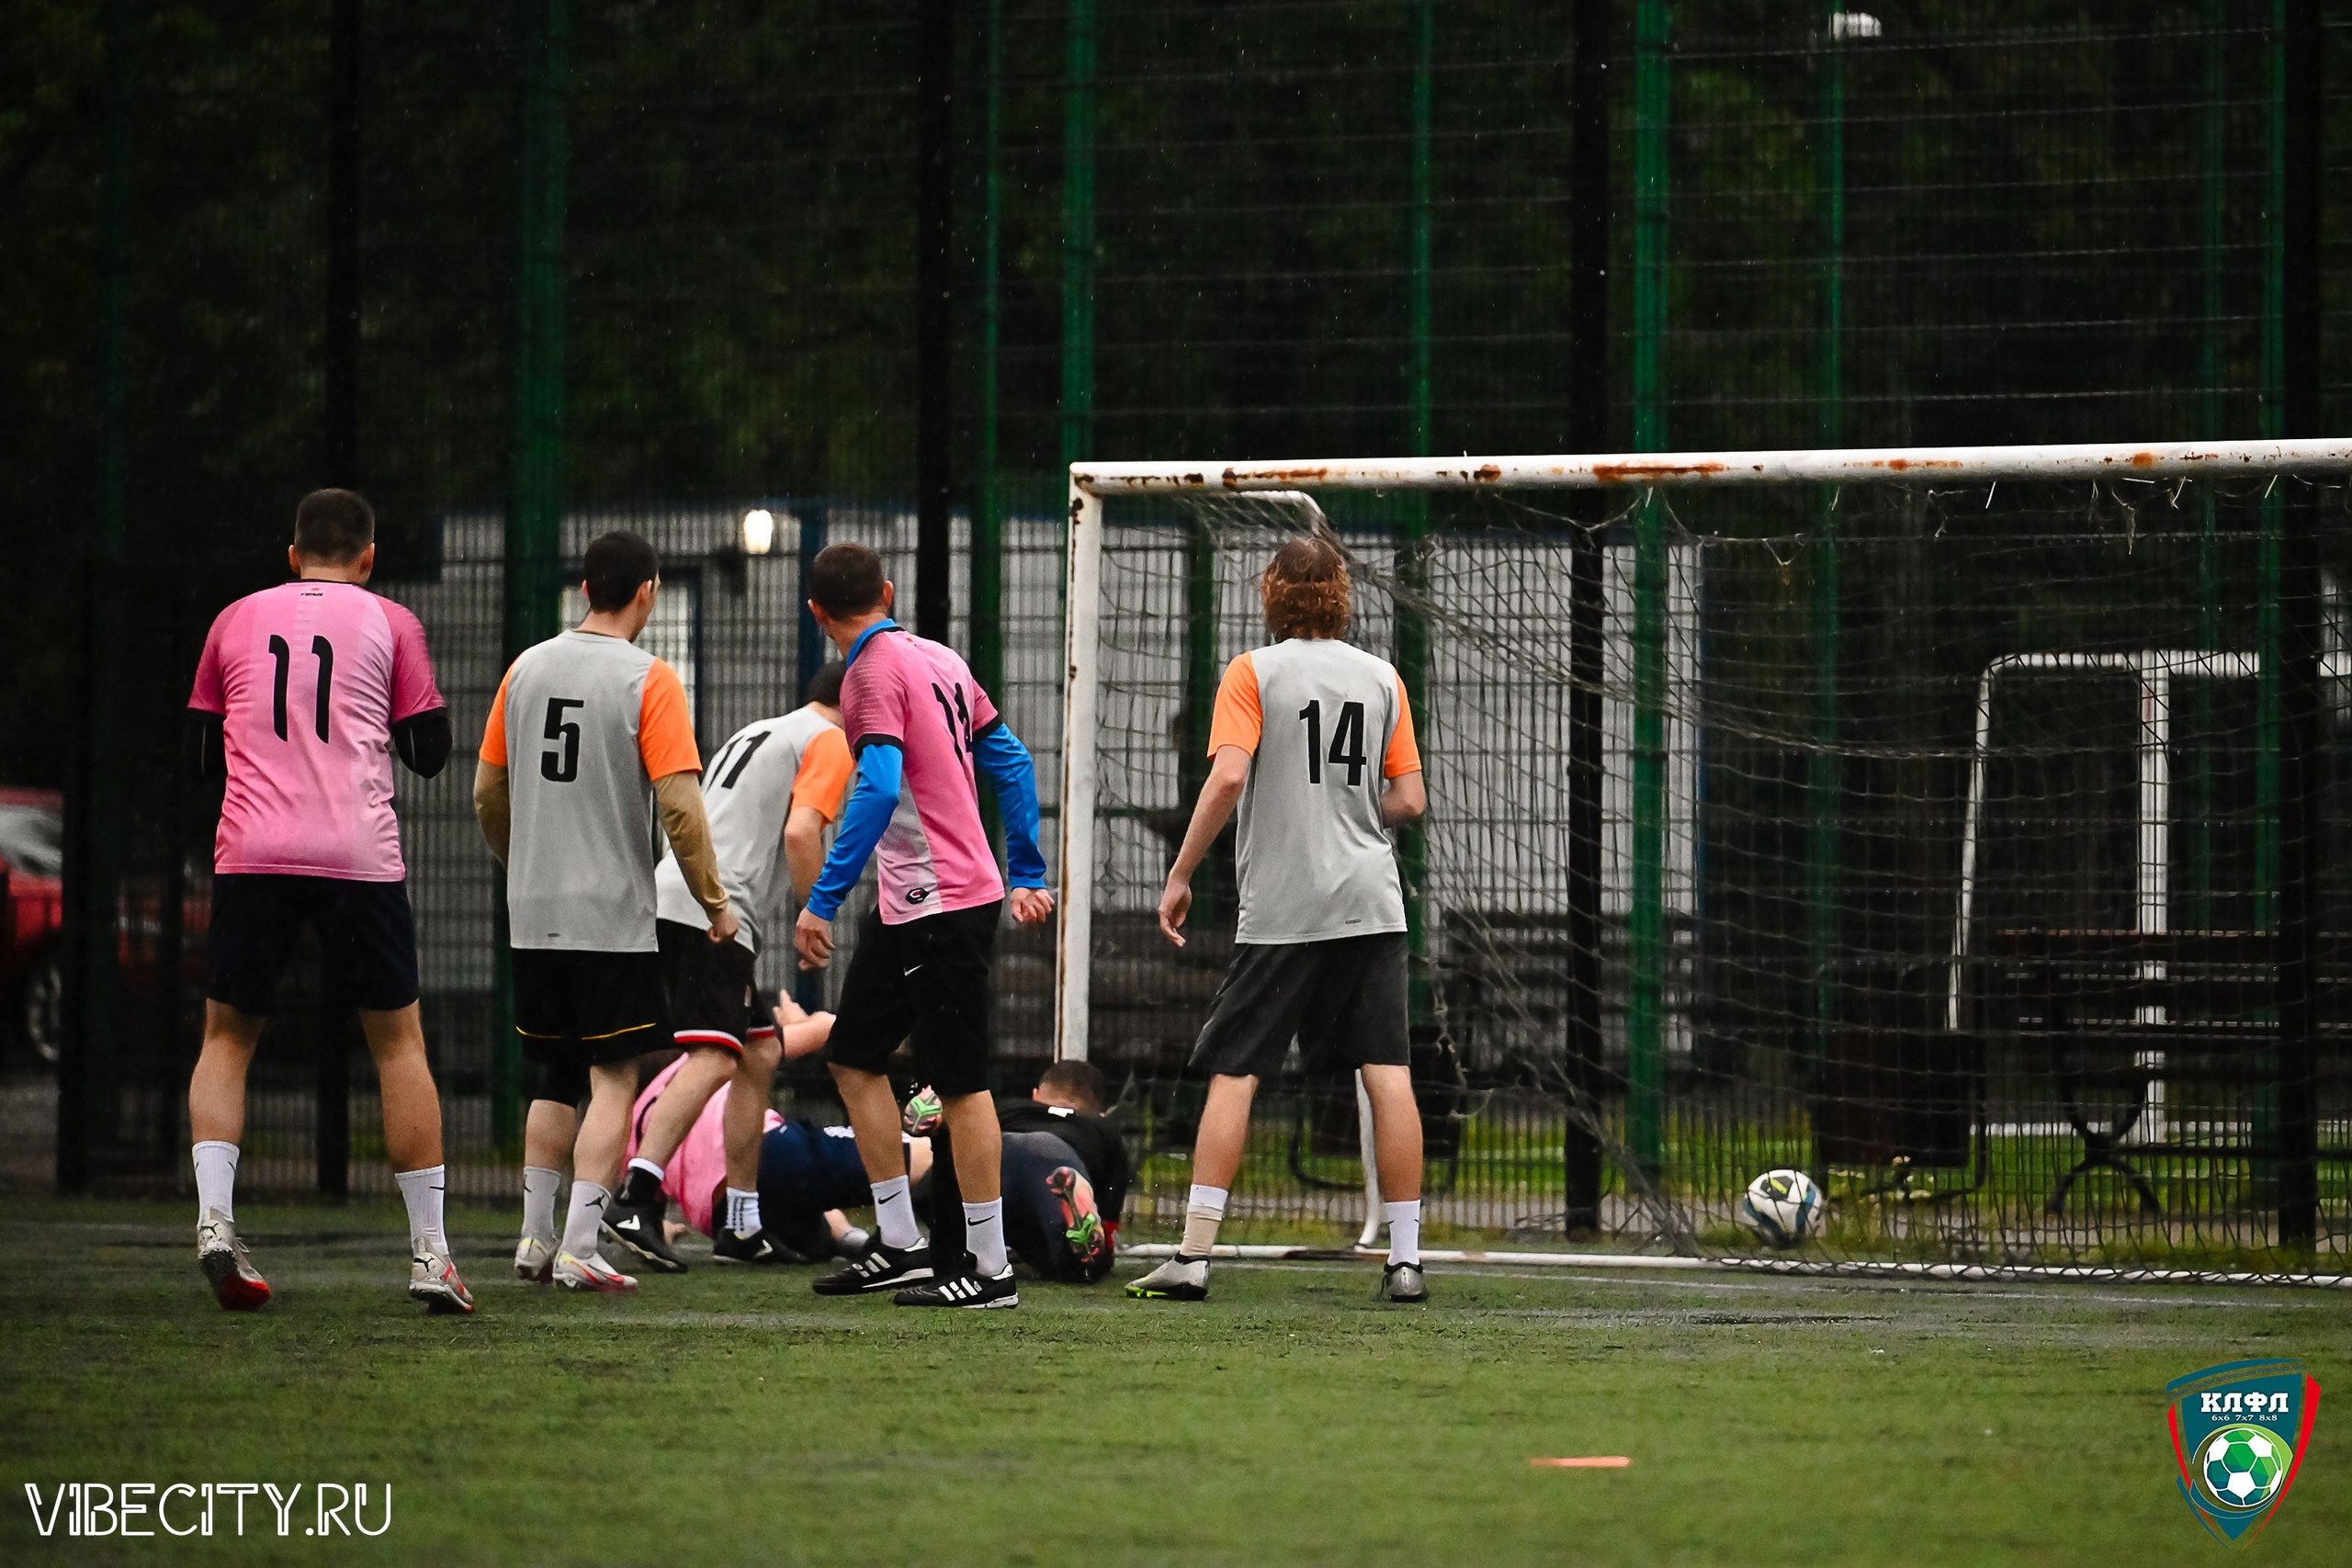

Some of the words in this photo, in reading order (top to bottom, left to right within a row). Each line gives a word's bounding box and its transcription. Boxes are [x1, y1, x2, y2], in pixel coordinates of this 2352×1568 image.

[268, 635, 334, 744] 11
[541, 697, 583, 783] 5
[1299, 699, 1366, 786] 14
